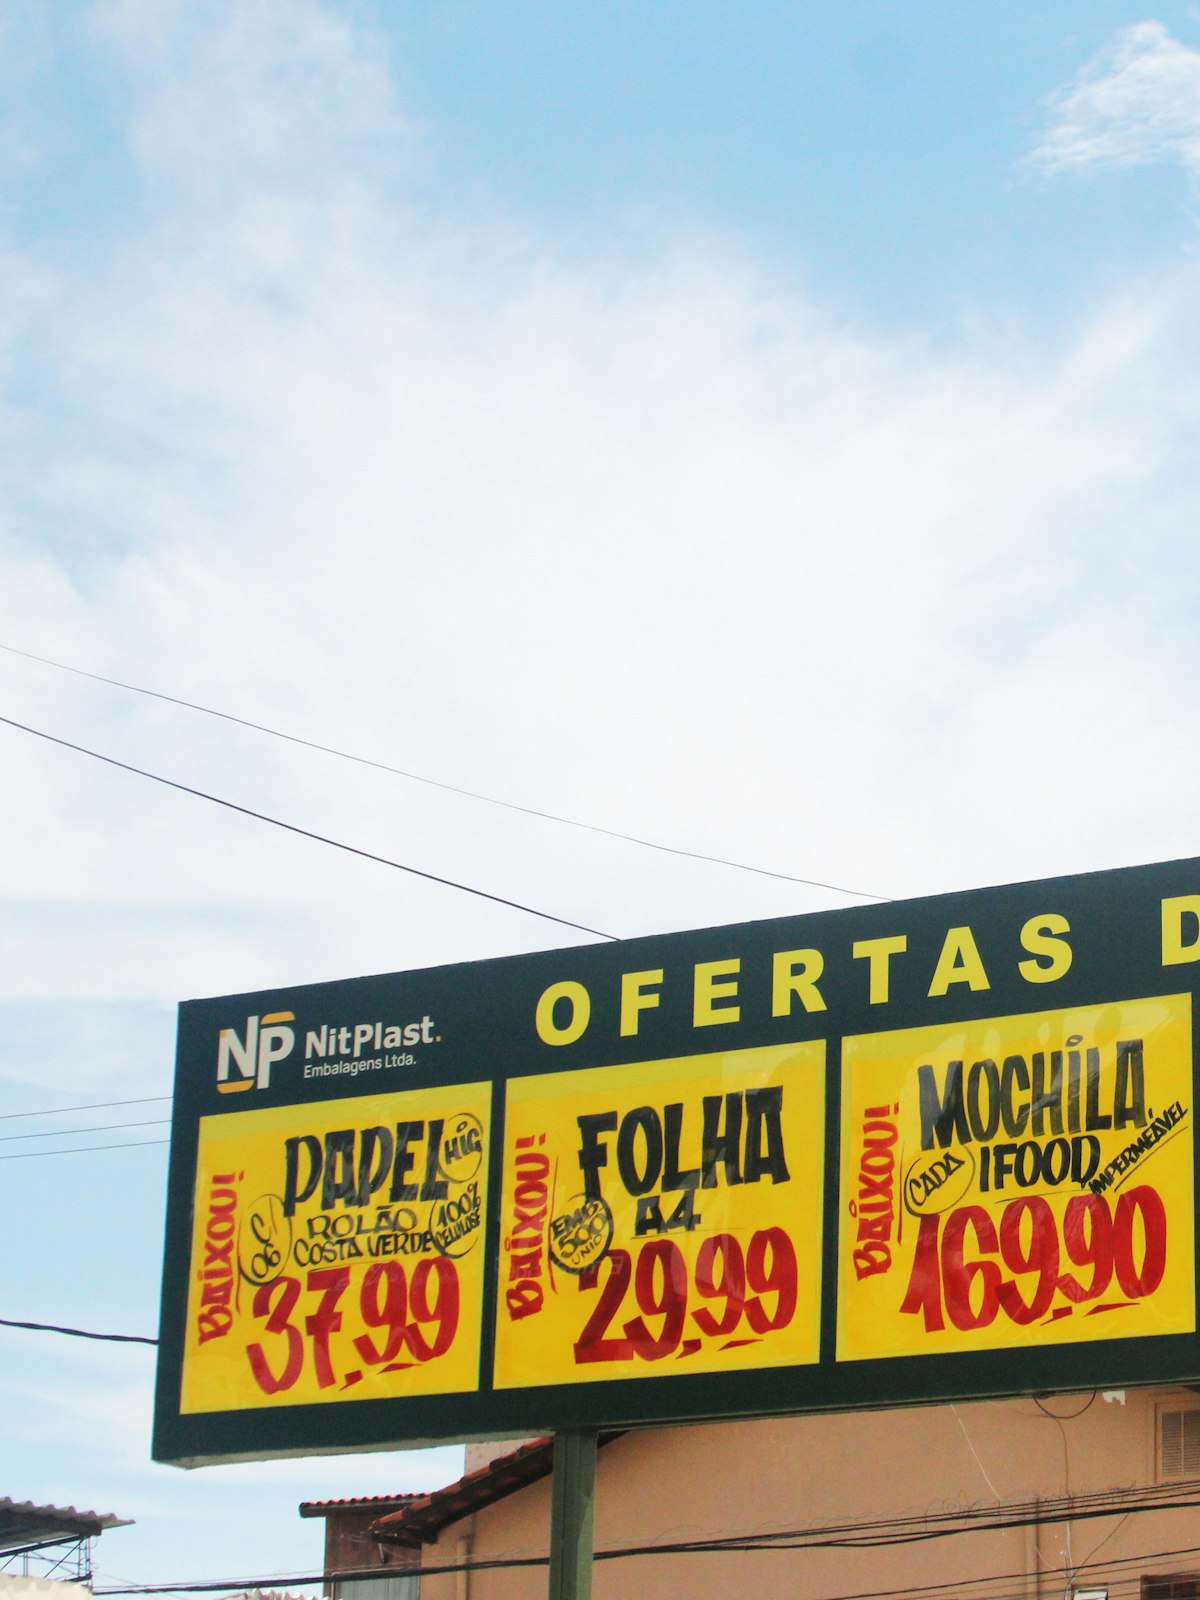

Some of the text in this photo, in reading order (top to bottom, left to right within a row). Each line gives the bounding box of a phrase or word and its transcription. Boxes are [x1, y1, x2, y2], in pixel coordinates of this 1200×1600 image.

[535, 914, 1073, 1046] OFERTAS
[216, 1011, 296, 1094] NP
[304, 1052, 417, 1078] Embalagens Ltda.
[917, 1034, 1148, 1151] MOCHILA
[283, 1119, 448, 1217] PAPEL
[577, 1085, 790, 1202] FOLHA
[980, 1135, 1101, 1192] IFOOD
[1089, 1101, 1188, 1195] IMPERMEÁVEL
[437, 1181, 481, 1227] 100%
[908, 1151, 965, 1206] CADA
[307, 1205, 417, 1239] ROLÃO
[558, 1213, 607, 1258] 500
[634, 1189, 702, 1236] A4
[250, 1243, 281, 1278] 06
[293, 1231, 434, 1267] COSTA VERDE
[573, 1226, 798, 1364] 29,99
[246, 1256, 460, 1395] 37,99
